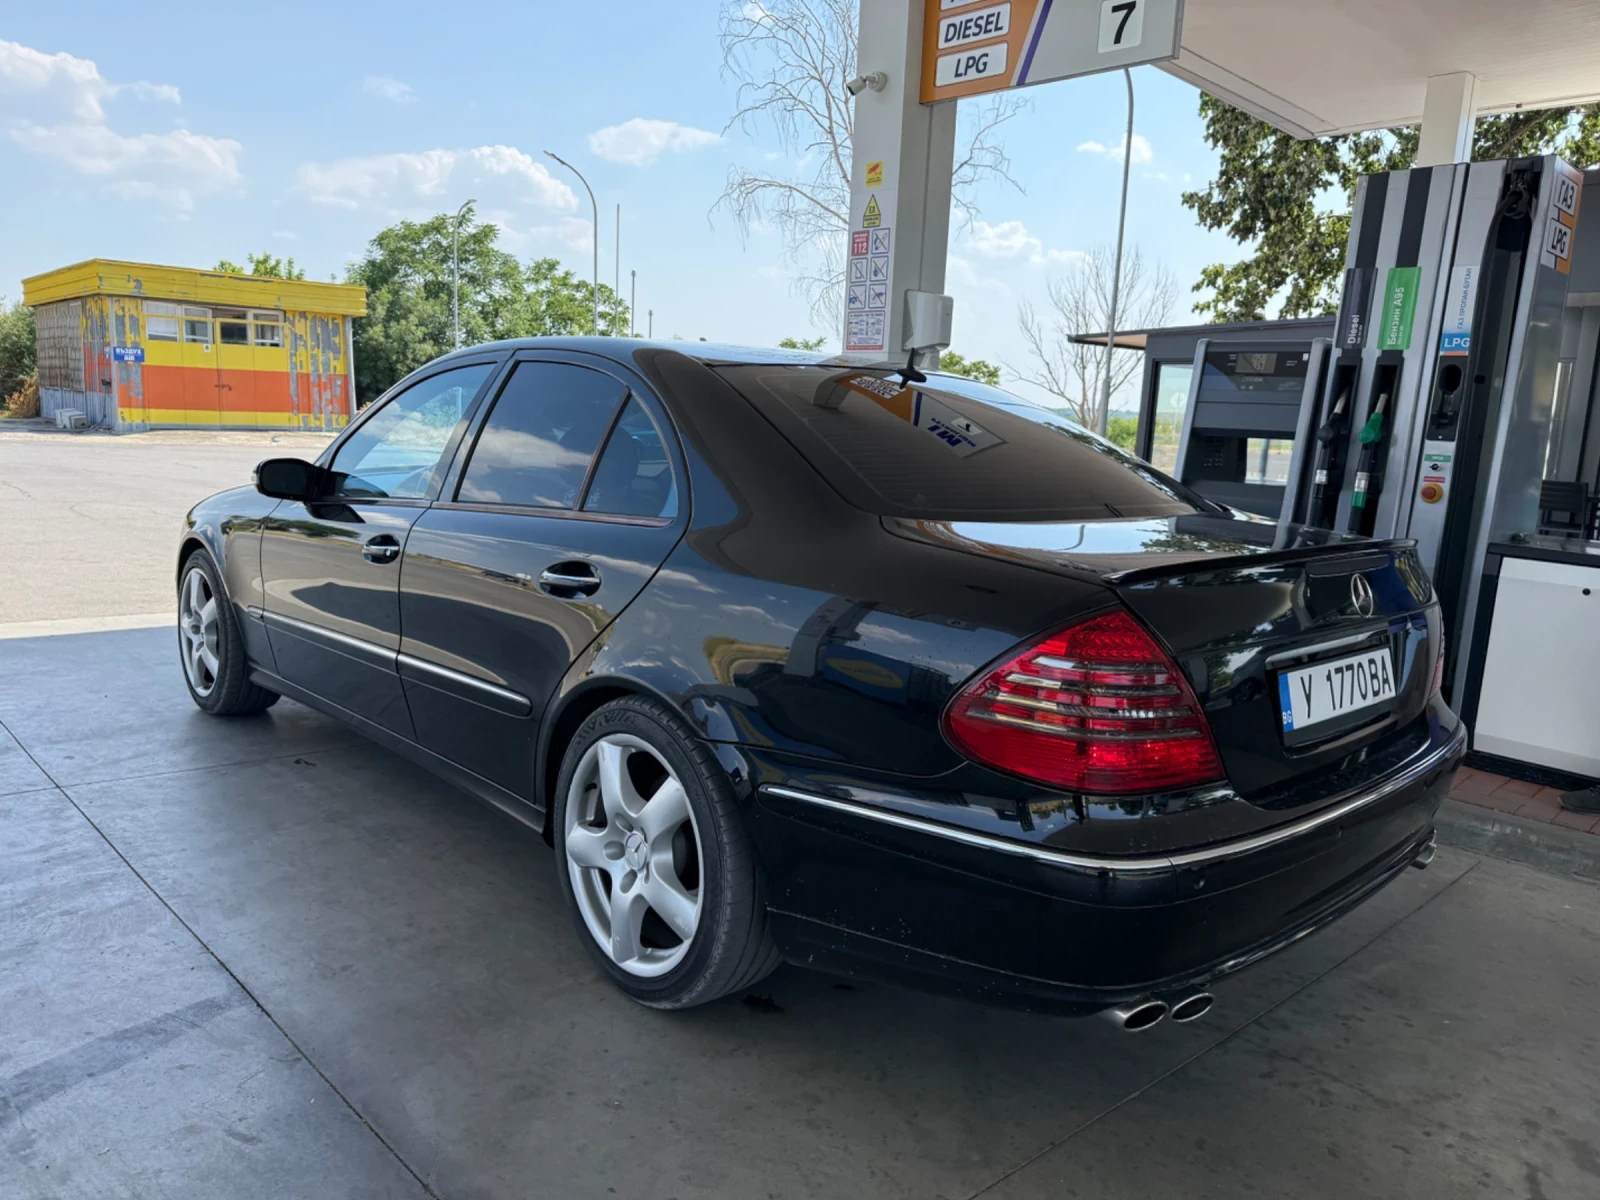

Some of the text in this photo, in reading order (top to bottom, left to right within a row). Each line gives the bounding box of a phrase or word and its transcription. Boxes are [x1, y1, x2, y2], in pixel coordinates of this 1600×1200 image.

[944, 11, 1004, 43] DIESEL
[1111, 1, 1136, 45] 7
[954, 53, 989, 78] LPG
[1558, 179, 1575, 210] ГАЗ
[854, 242, 867, 255] 112
[1551, 226, 1567, 254] LPG
[1347, 314, 1360, 344] Diesel
[1387, 308, 1402, 345] Бензин
[1457, 318, 1465, 329] ГАЗ
[1444, 337, 1471, 348] LPG
[1282, 710, 1293, 725] BG
